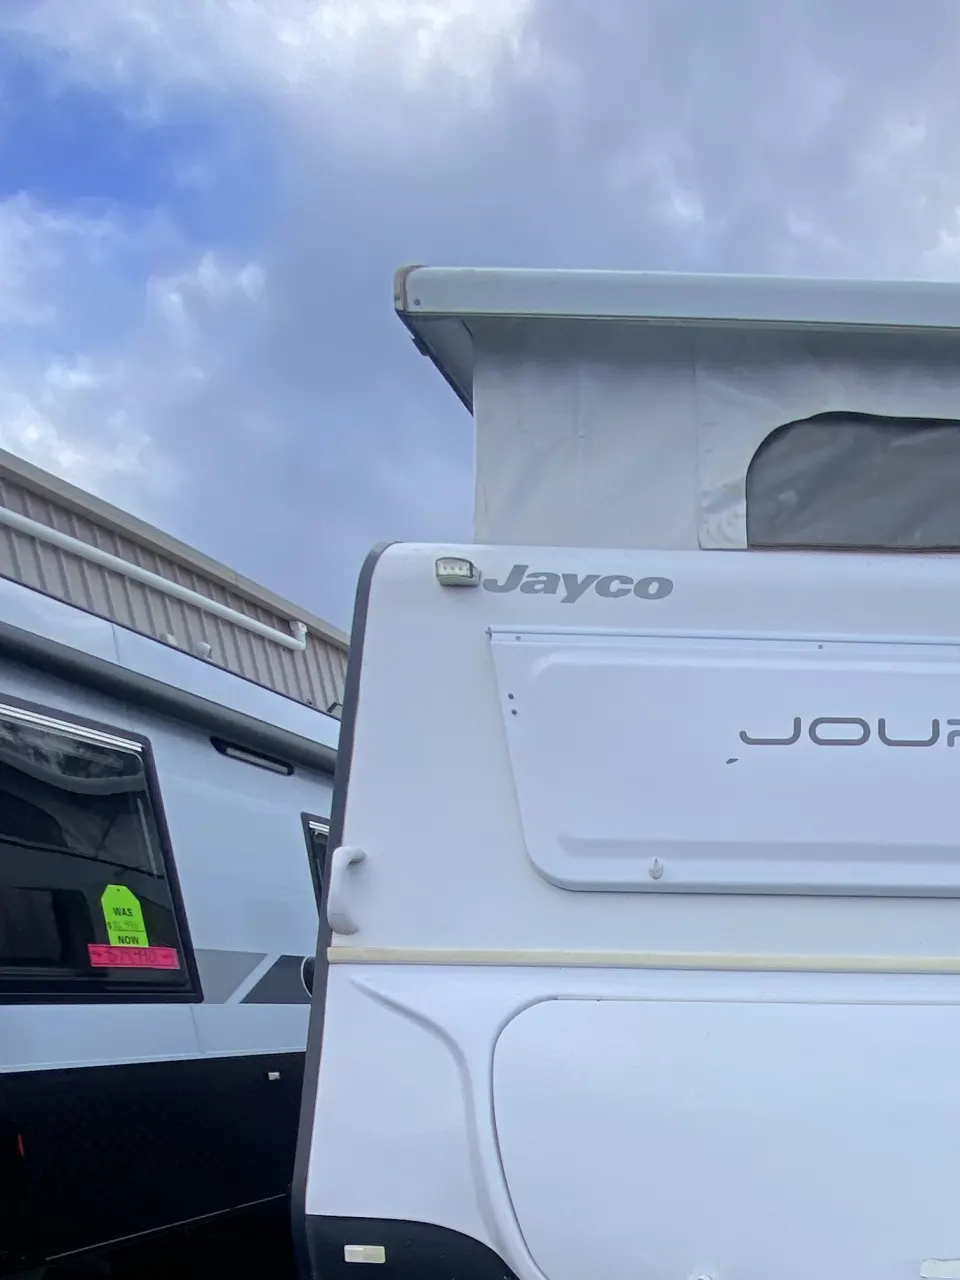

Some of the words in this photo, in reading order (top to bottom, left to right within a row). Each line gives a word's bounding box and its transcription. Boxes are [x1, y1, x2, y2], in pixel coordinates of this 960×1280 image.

[482, 564, 674, 603] Jayco
[112, 907, 134, 917] WAS
[117, 935, 140, 945] NOW
